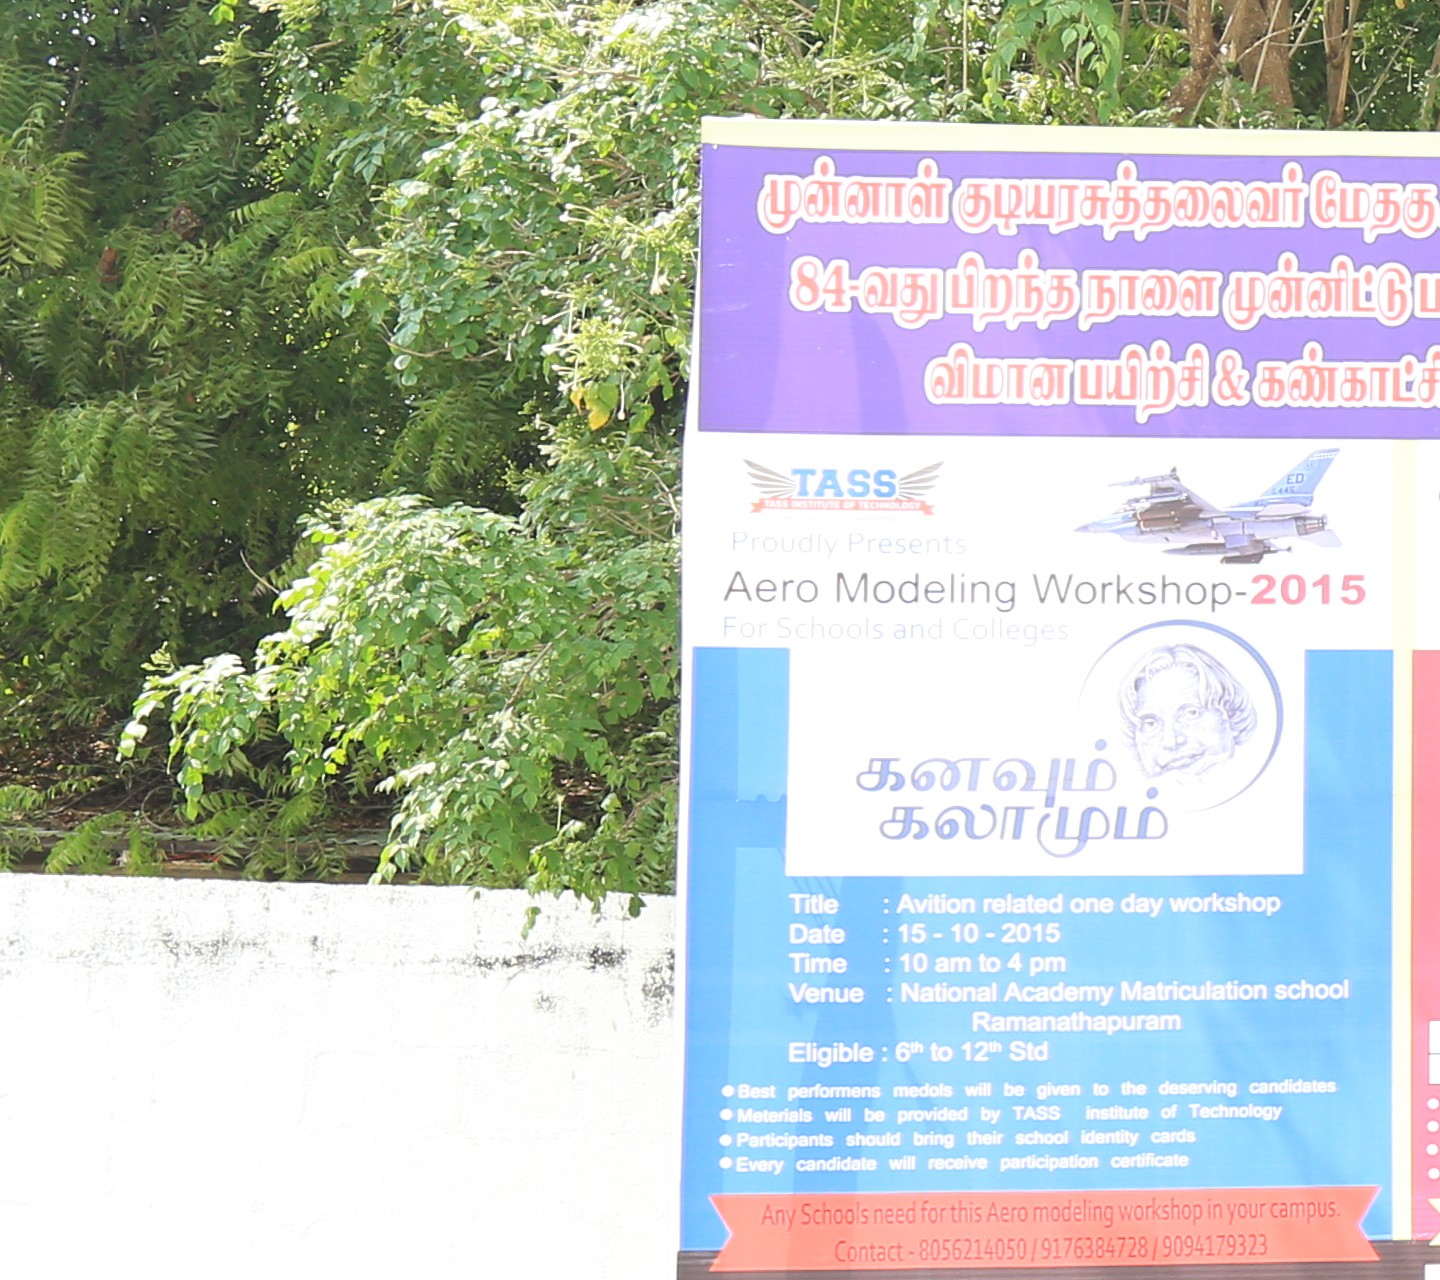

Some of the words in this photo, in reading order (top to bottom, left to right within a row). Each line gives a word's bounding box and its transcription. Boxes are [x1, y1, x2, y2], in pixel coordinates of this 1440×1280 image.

[760, 160, 950, 232] முன்னாள்
[1311, 169, 1439, 238] மேதகு
[792, 258, 943, 327] 84-வது
[947, 250, 1078, 330] பிறந்த
[1080, 269, 1221, 330] நாளை
[1227, 252, 1412, 328] முன்னிட்டு
[926, 344, 1071, 405] விமான
[1075, 341, 1209, 423] பயிற்சி
[1213, 350, 1249, 405] &
[791, 468, 897, 497] TASS
[732, 531, 837, 559] Proudly
[849, 532, 966, 555] Presents
[724, 571, 818, 603] Aero
[836, 572, 1016, 612] Modeling
[1033, 574, 1366, 612] Workshop-2015
[855, 739, 1116, 808] கனவும்
[880, 787, 1167, 858] கலாமும்
[790, 894, 839, 915] Title
[897, 894, 978, 914] Avition
[984, 893, 1063, 913] related
[1070, 898, 1115, 914] one
[1121, 894, 1163, 917] day
[1169, 893, 1281, 918] workshop
[790, 925, 845, 944] Date
[898, 924, 926, 943] 15
[951, 924, 979, 943] 10
[1002, 924, 1060, 943] 2015
[790, 953, 847, 974] Time
[900, 954, 927, 974] 10
[936, 958, 972, 973] am
[980, 954, 1001, 973] to
[1008, 953, 1022, 972] 4
[1030, 957, 1066, 978] pm
[789, 983, 864, 1003] Venue
[902, 981, 997, 1002] National
[1005, 980, 1112, 1006] Academy
[1121, 979, 1268, 1001] Matriculation
[1274, 979, 1349, 999] school
[972, 1011, 1181, 1035] Ramanathapuram
[789, 1042, 874, 1068] Eligible
[895, 1041, 924, 1062] 6th
[931, 1042, 952, 1062] to
[961, 1040, 1002, 1062] 12th
[1010, 1041, 1048, 1061] Std
[736, 1157, 784, 1175] Every
[796, 1156, 877, 1172] candidate
[889, 1155, 916, 1170] will
[928, 1155, 987, 1170] receive
[1000, 1153, 1099, 1171] participation
[1110, 1153, 1189, 1169] certificate
[835, 1240, 904, 1263] Contact
